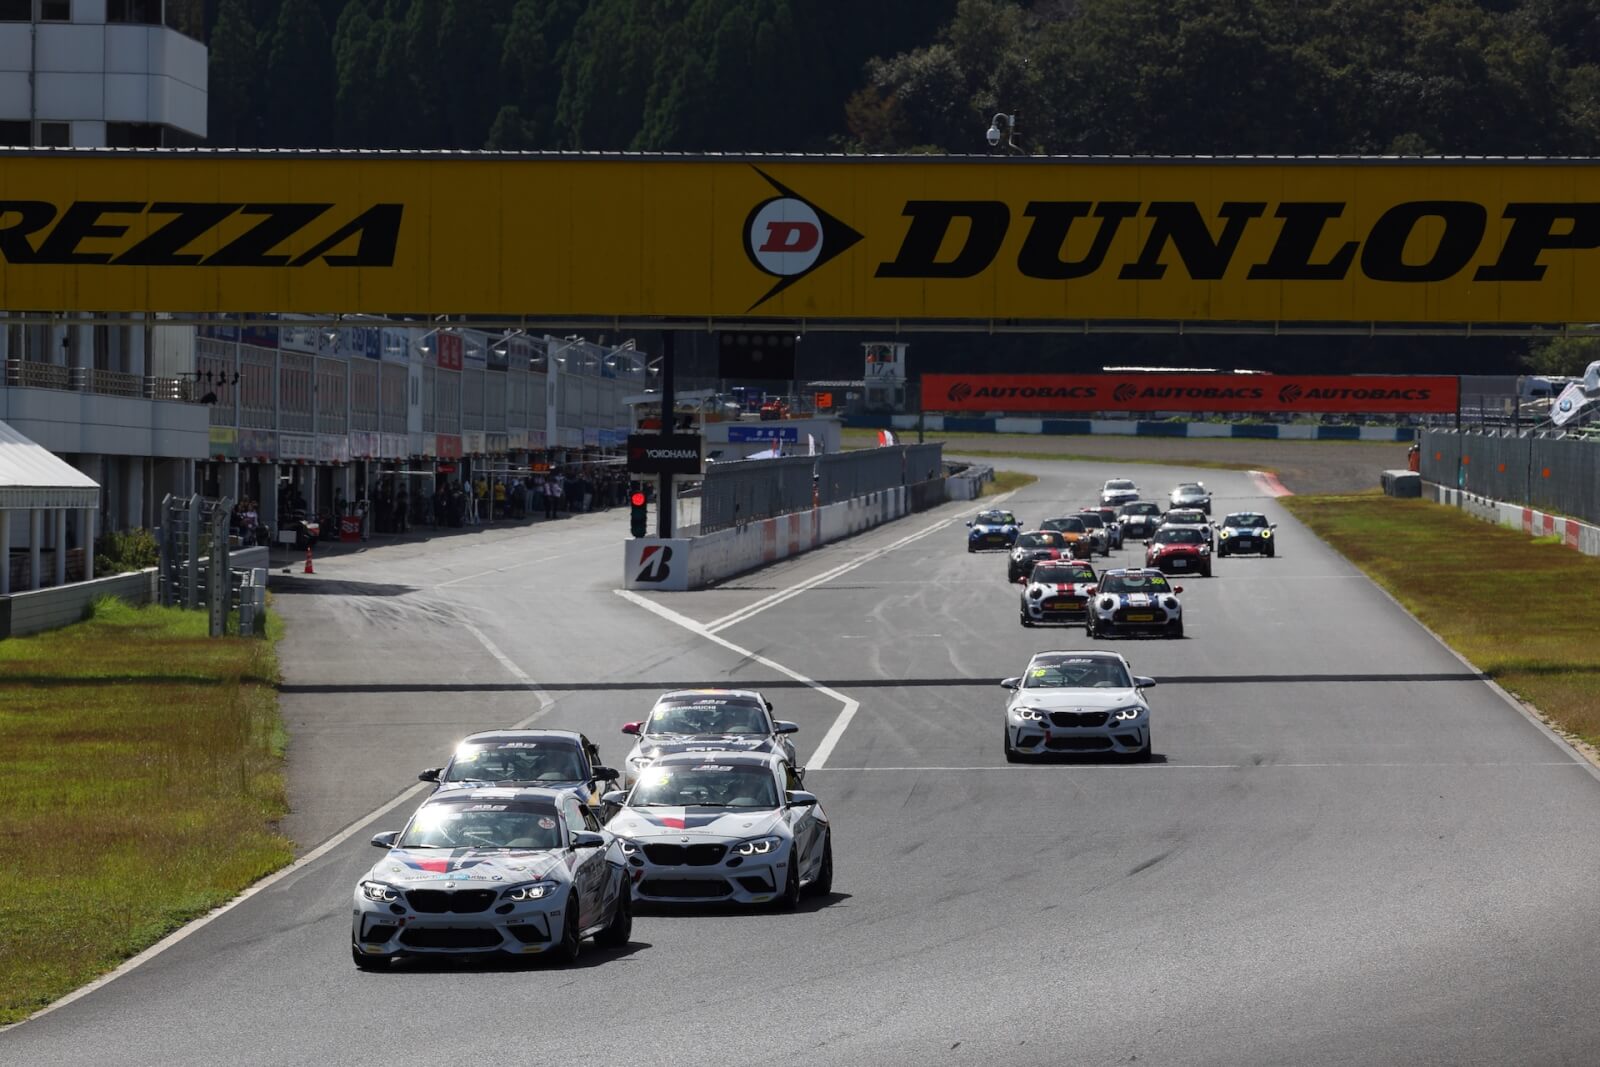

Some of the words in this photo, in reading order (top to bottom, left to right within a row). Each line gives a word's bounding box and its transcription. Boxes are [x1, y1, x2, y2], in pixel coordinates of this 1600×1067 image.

[758, 221, 820, 253] D
[874, 199, 1600, 282] DUNLOP
[974, 386, 1097, 399] AUTOBACS
[1139, 386, 1264, 399] AUTOBACS
[1304, 387, 1431, 401] AUTOBACS
[646, 449, 698, 458] YOKOHAMA
